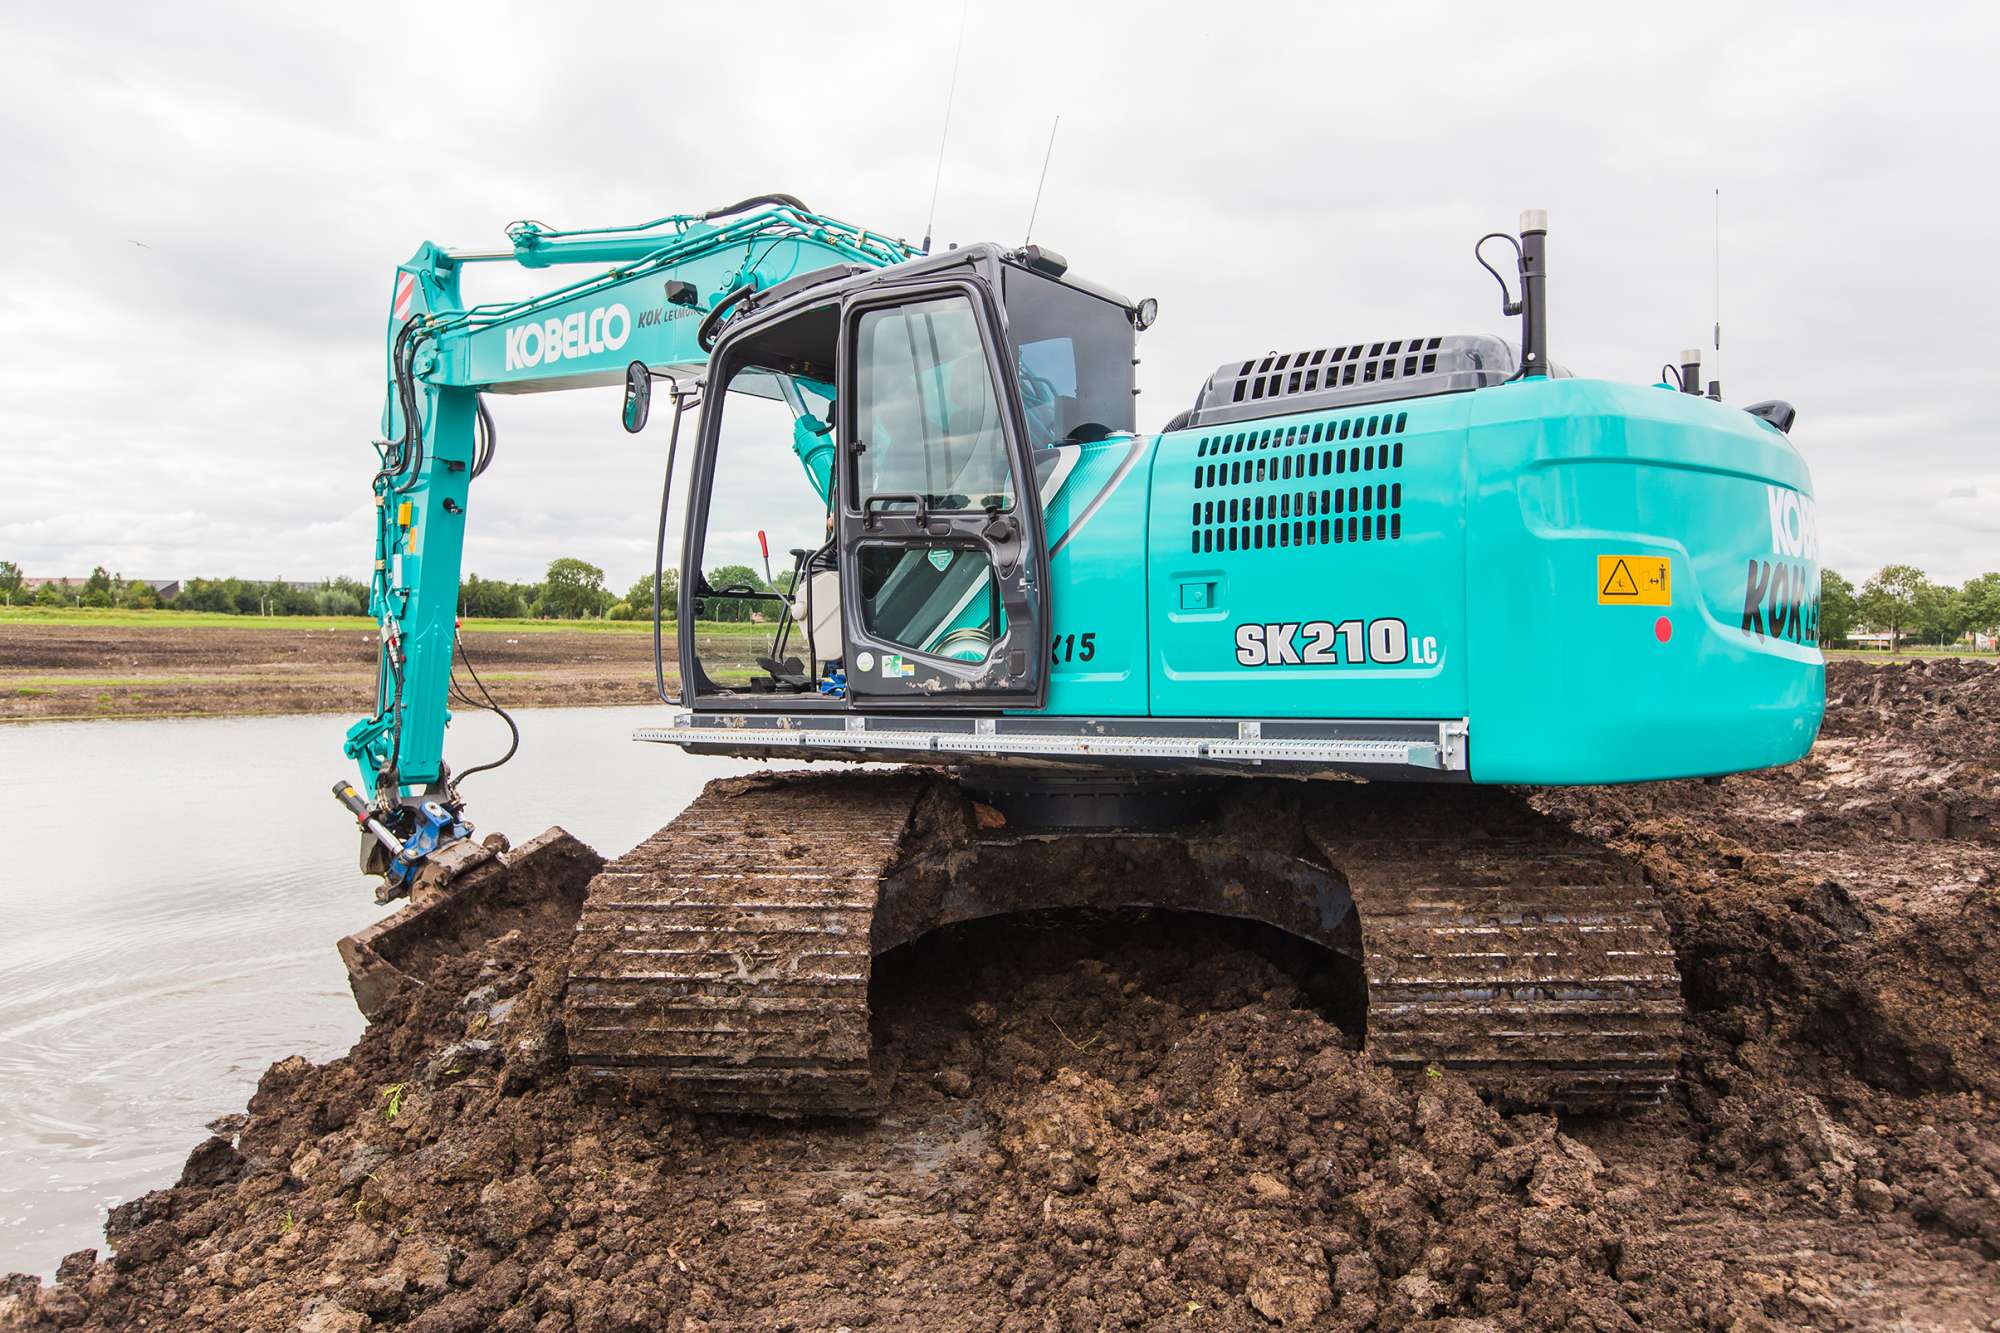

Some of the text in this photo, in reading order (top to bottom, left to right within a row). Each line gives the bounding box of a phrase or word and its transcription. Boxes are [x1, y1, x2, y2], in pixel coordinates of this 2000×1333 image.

[505, 303, 632, 371] KOBELCO
[637, 307, 663, 329] KOK
[1741, 559, 1807, 645] KOK
[1236, 617, 1437, 667] SK210 LC
